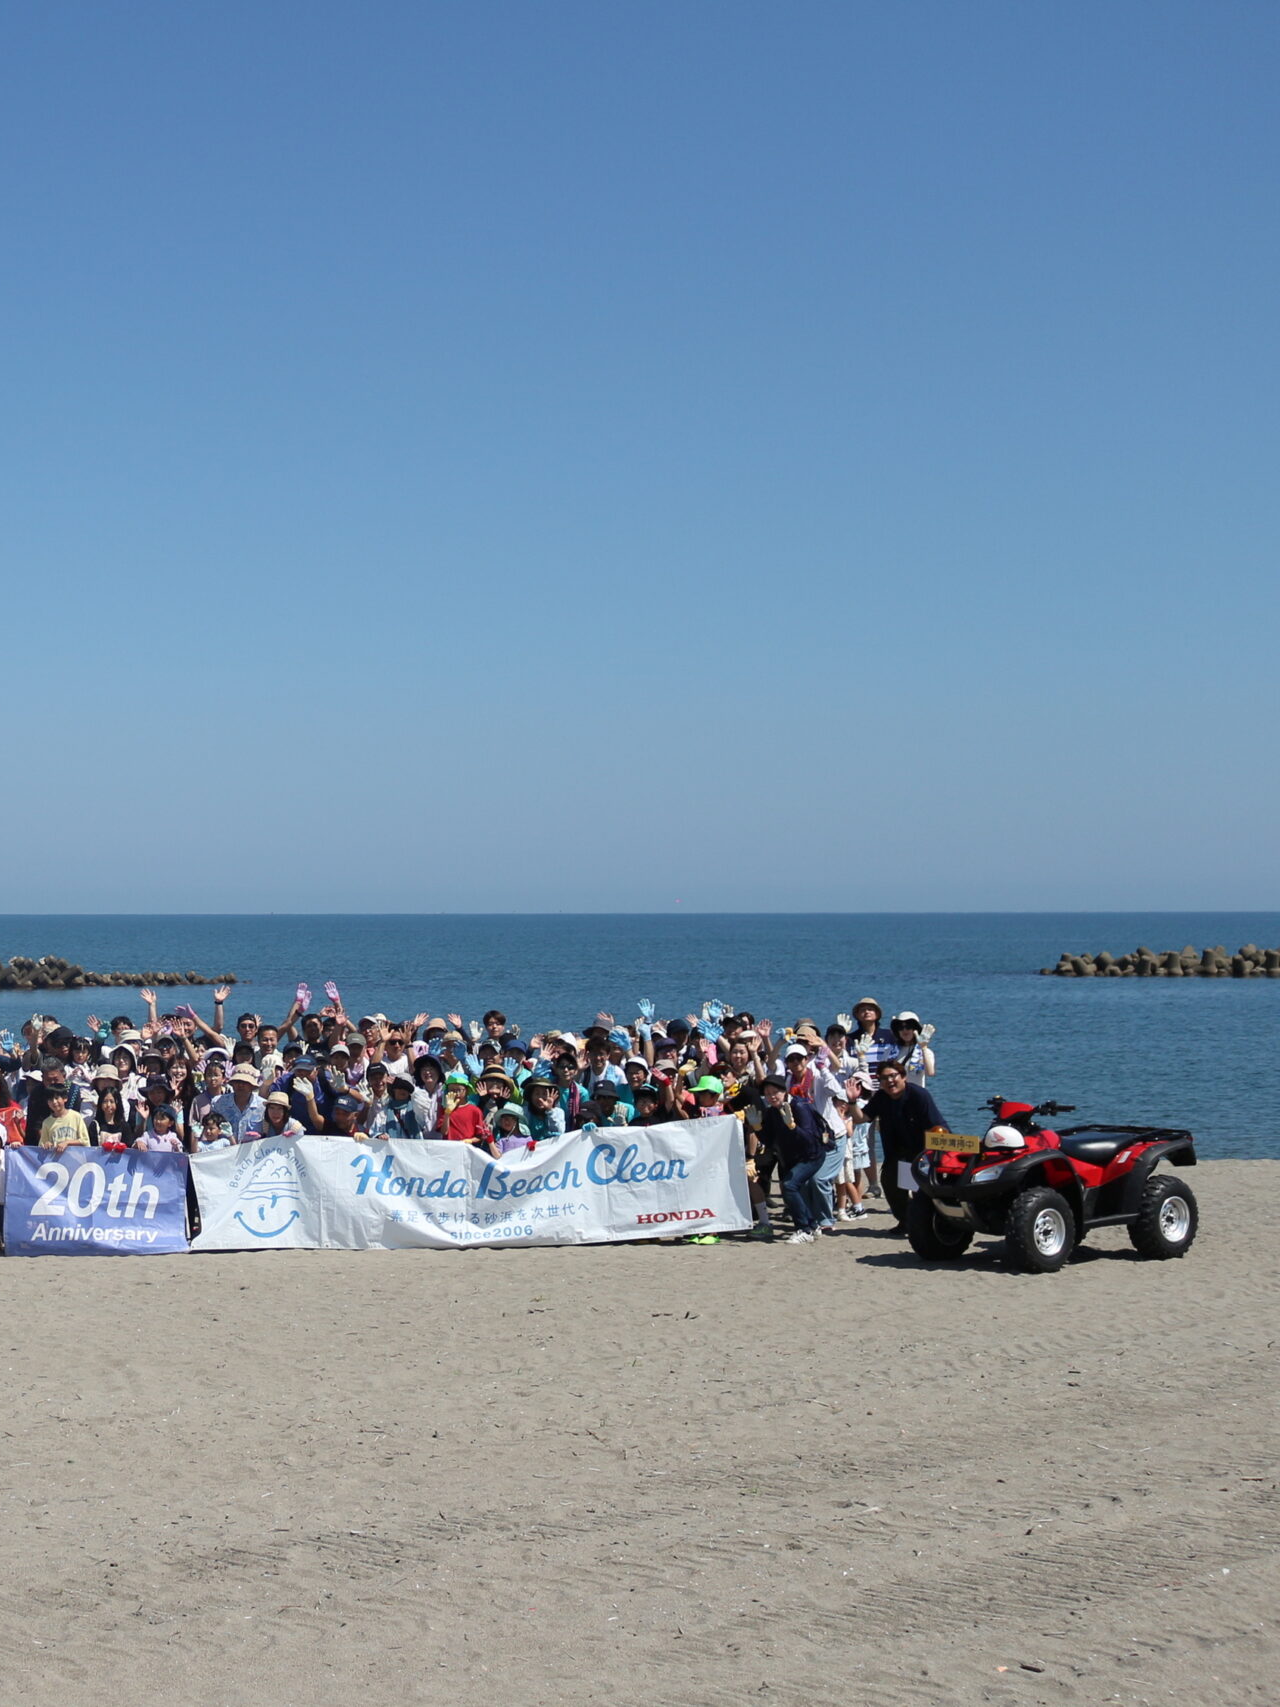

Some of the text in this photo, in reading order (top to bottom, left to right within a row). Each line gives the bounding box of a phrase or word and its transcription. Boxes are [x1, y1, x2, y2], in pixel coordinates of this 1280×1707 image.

[229, 1147, 306, 1188] Beach Clean Smile
[350, 1143, 688, 1200] Honda Beach Clean
[30, 1162, 160, 1219] 20th
[390, 1202, 590, 1225] 素足で歩ける砂浜を次世代へ
[636, 1208, 717, 1225] HONDA
[31, 1223, 158, 1243] Anniversary
[450, 1225, 534, 1240] since2006
